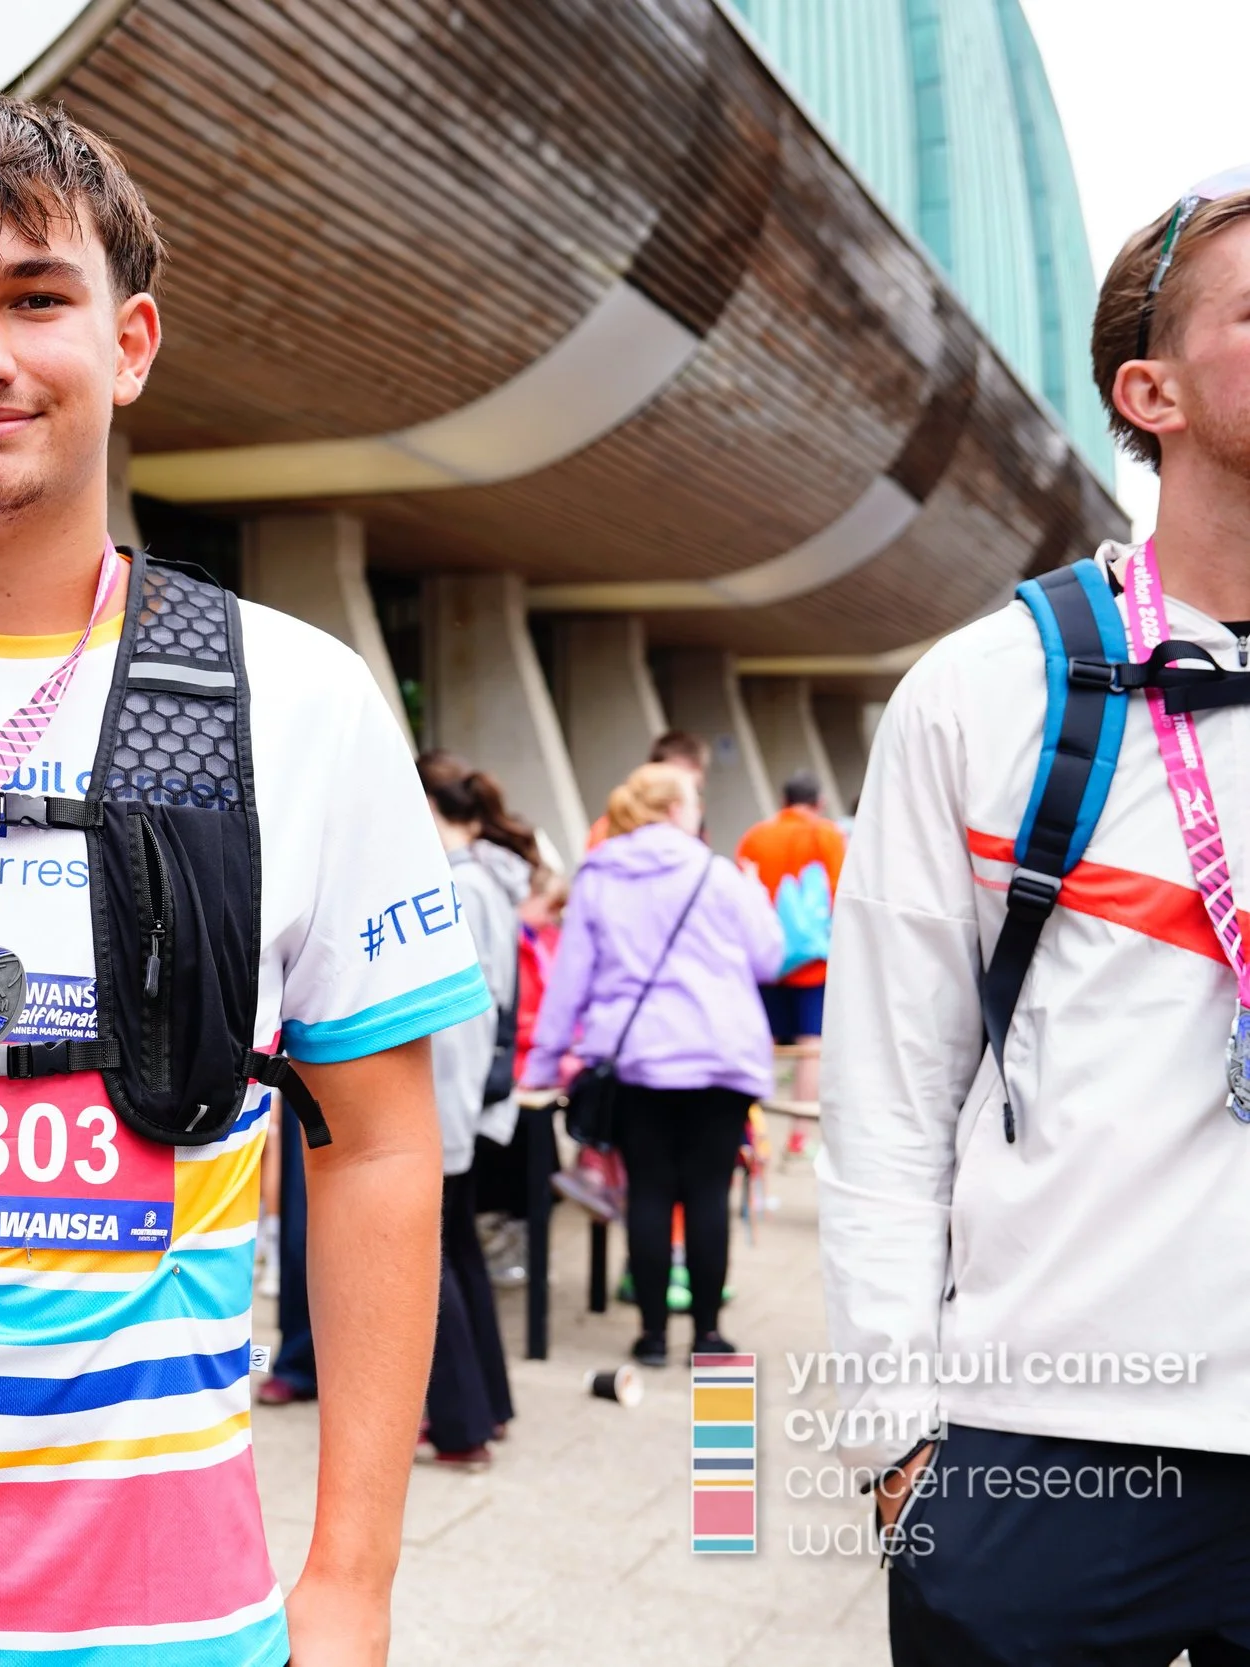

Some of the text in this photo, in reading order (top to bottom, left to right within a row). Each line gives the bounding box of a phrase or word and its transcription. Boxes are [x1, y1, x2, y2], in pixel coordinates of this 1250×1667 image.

[1173, 712, 1198, 769] TRUNNER
[26, 982, 97, 1009] WANS
[11, 1026, 38, 1035] ANNER
[39, 1027, 83, 1038] MARATHON
